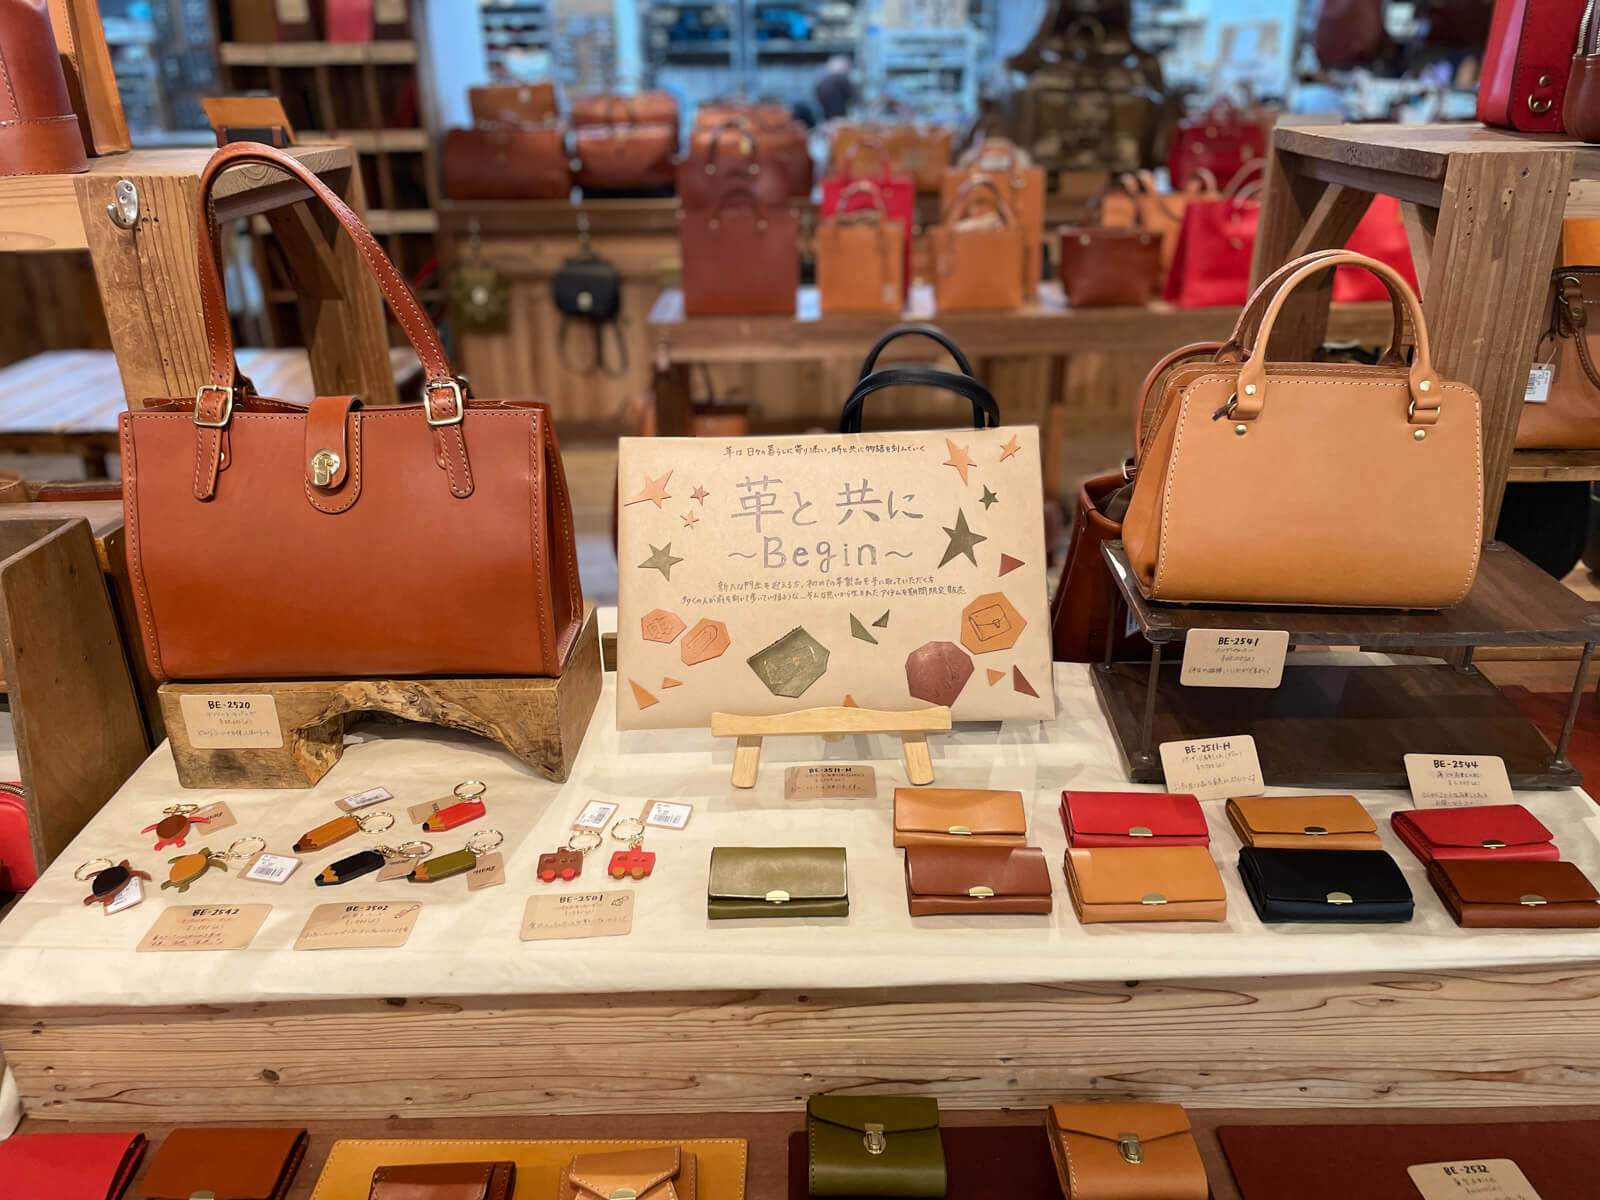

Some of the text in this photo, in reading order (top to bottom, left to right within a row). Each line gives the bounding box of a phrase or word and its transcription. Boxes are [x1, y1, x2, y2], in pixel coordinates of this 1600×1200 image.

[731, 475, 924, 533] 革と共に
[1218, 636, 1260, 647] BE-2541
[207, 700, 251, 710] BE-2520
[1433, 759, 1479, 769] BE-2544
[559, 894, 604, 904] BE-2501
[192, 908, 240, 917] BE-2542
[345, 904, 389, 913] BE-2502
[1443, 1164, 1490, 1176] BE-2532
